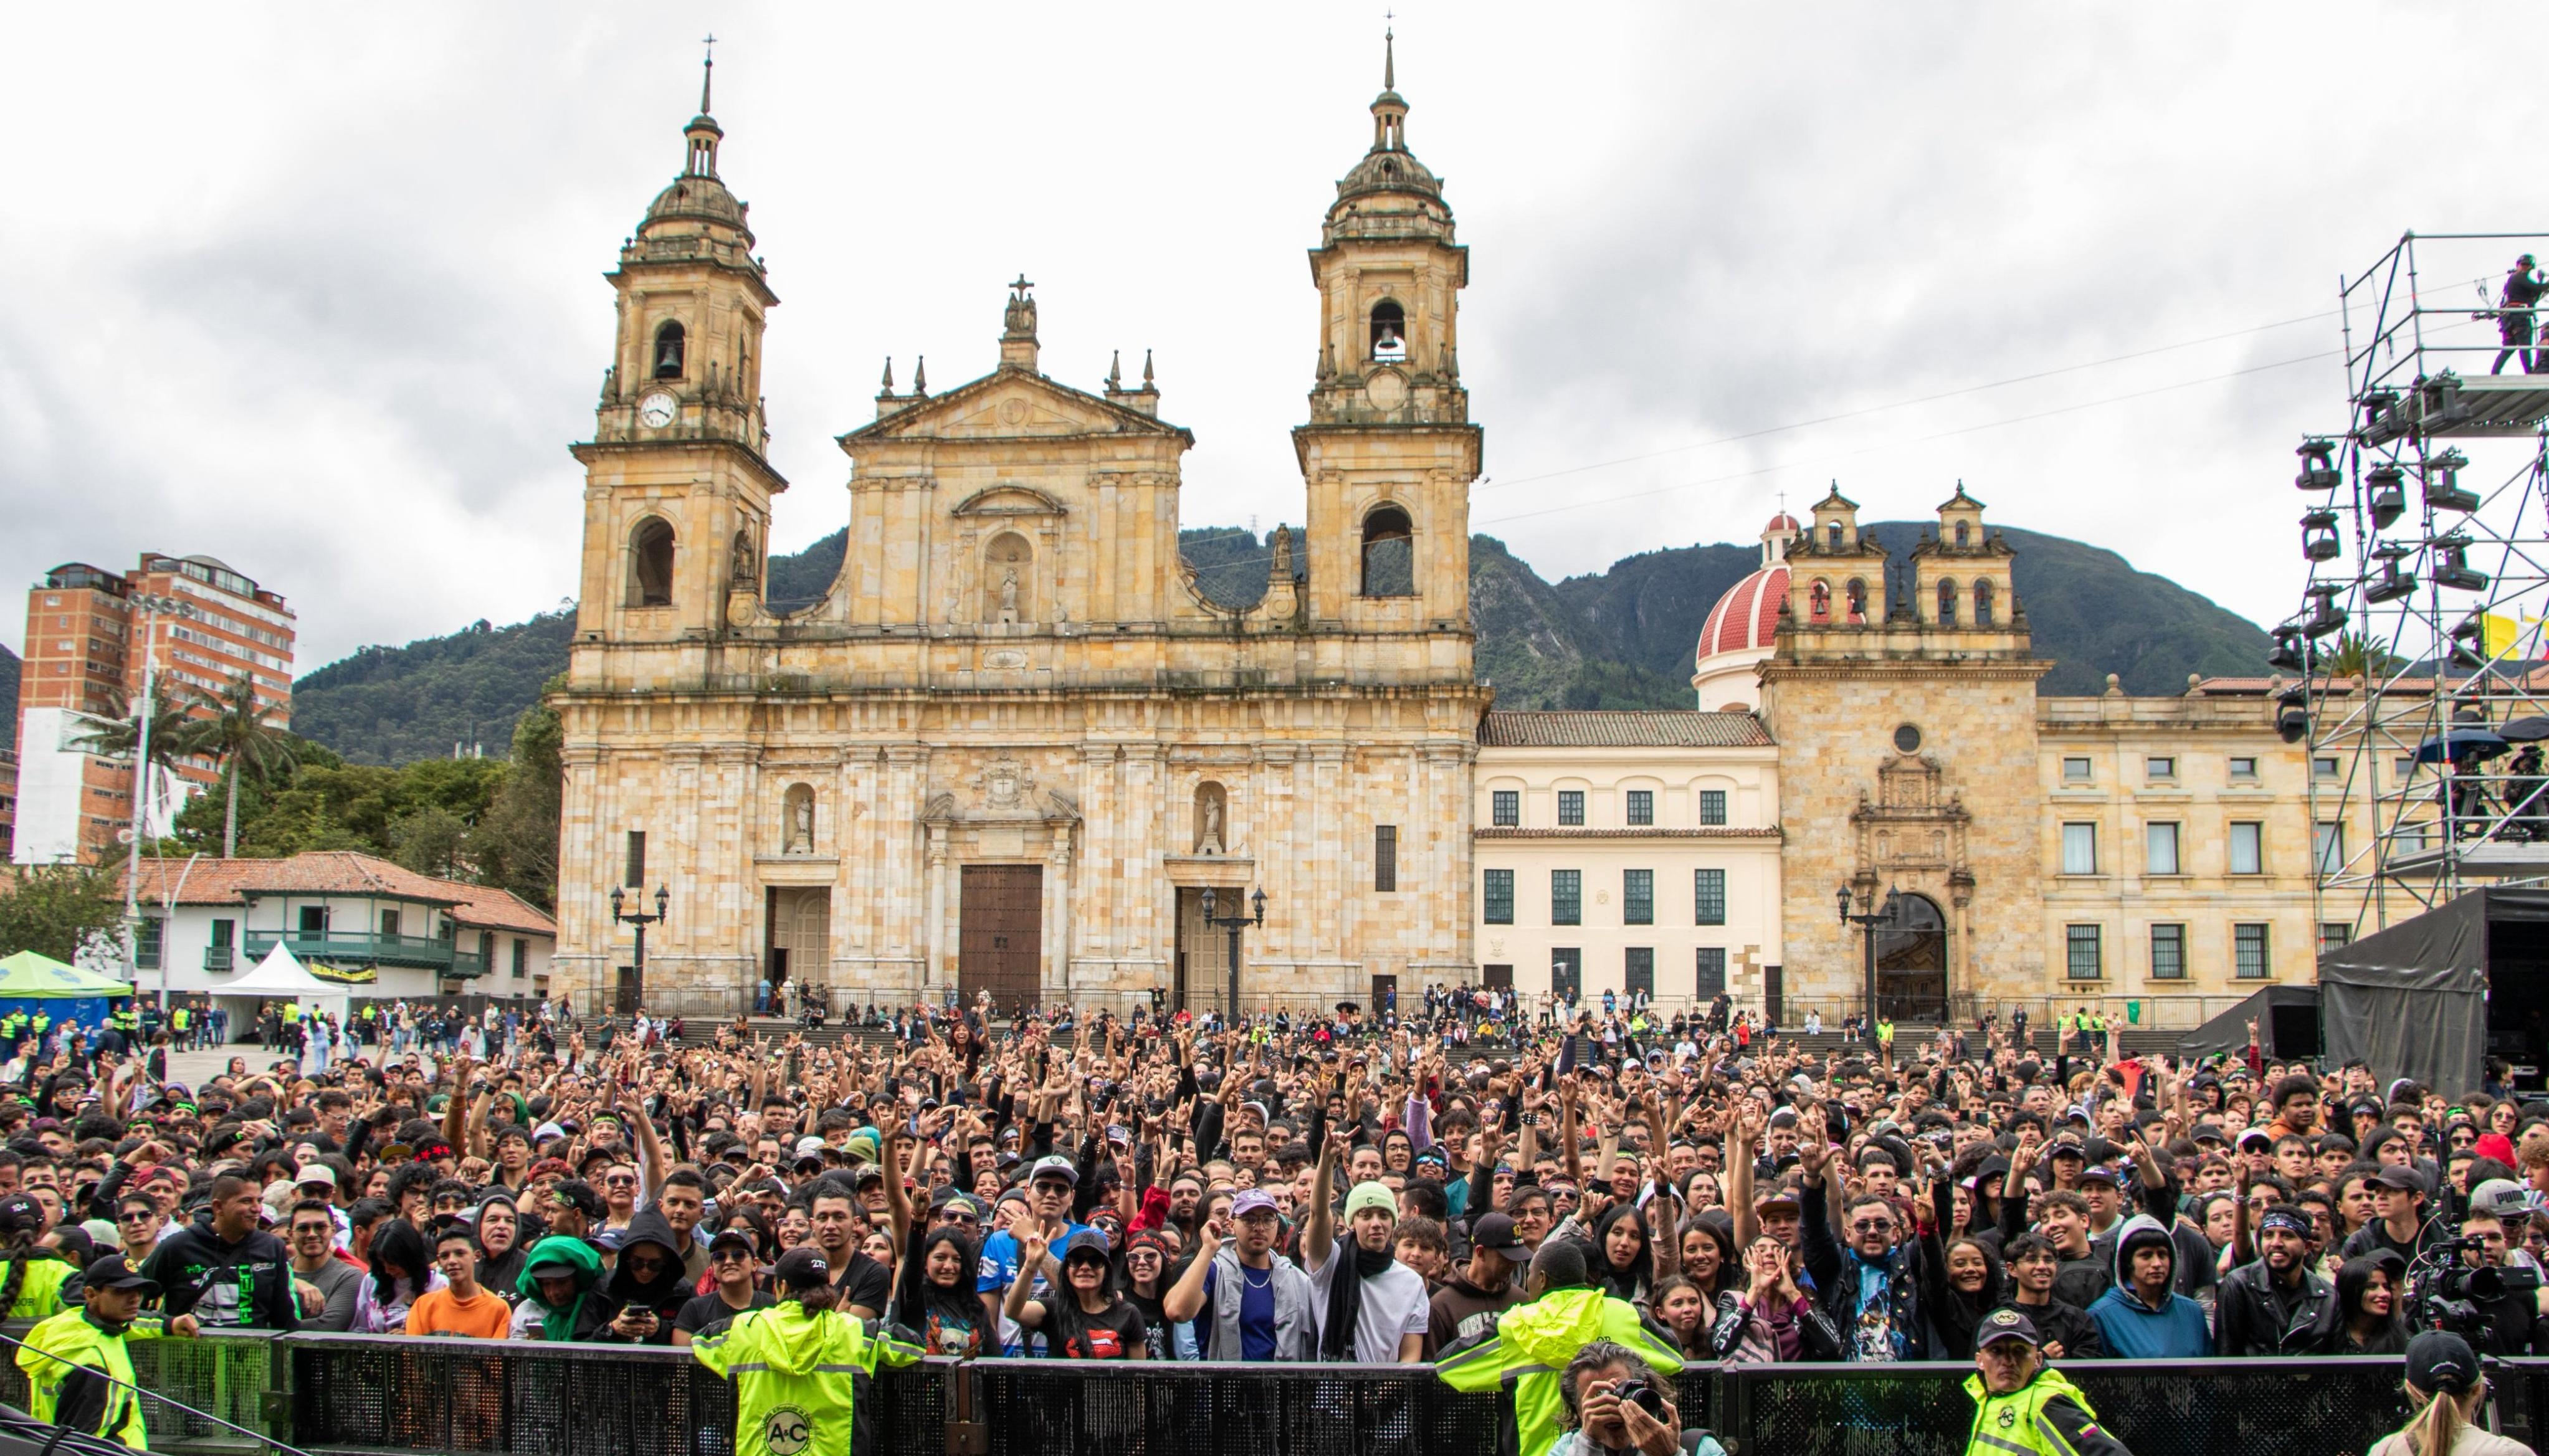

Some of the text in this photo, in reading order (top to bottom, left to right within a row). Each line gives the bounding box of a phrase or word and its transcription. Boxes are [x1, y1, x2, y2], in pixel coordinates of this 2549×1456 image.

[1366, 1197, 1373, 1205] C
[811, 1259, 826, 1269] 277
[769, 1422, 808, 1443] A&C
